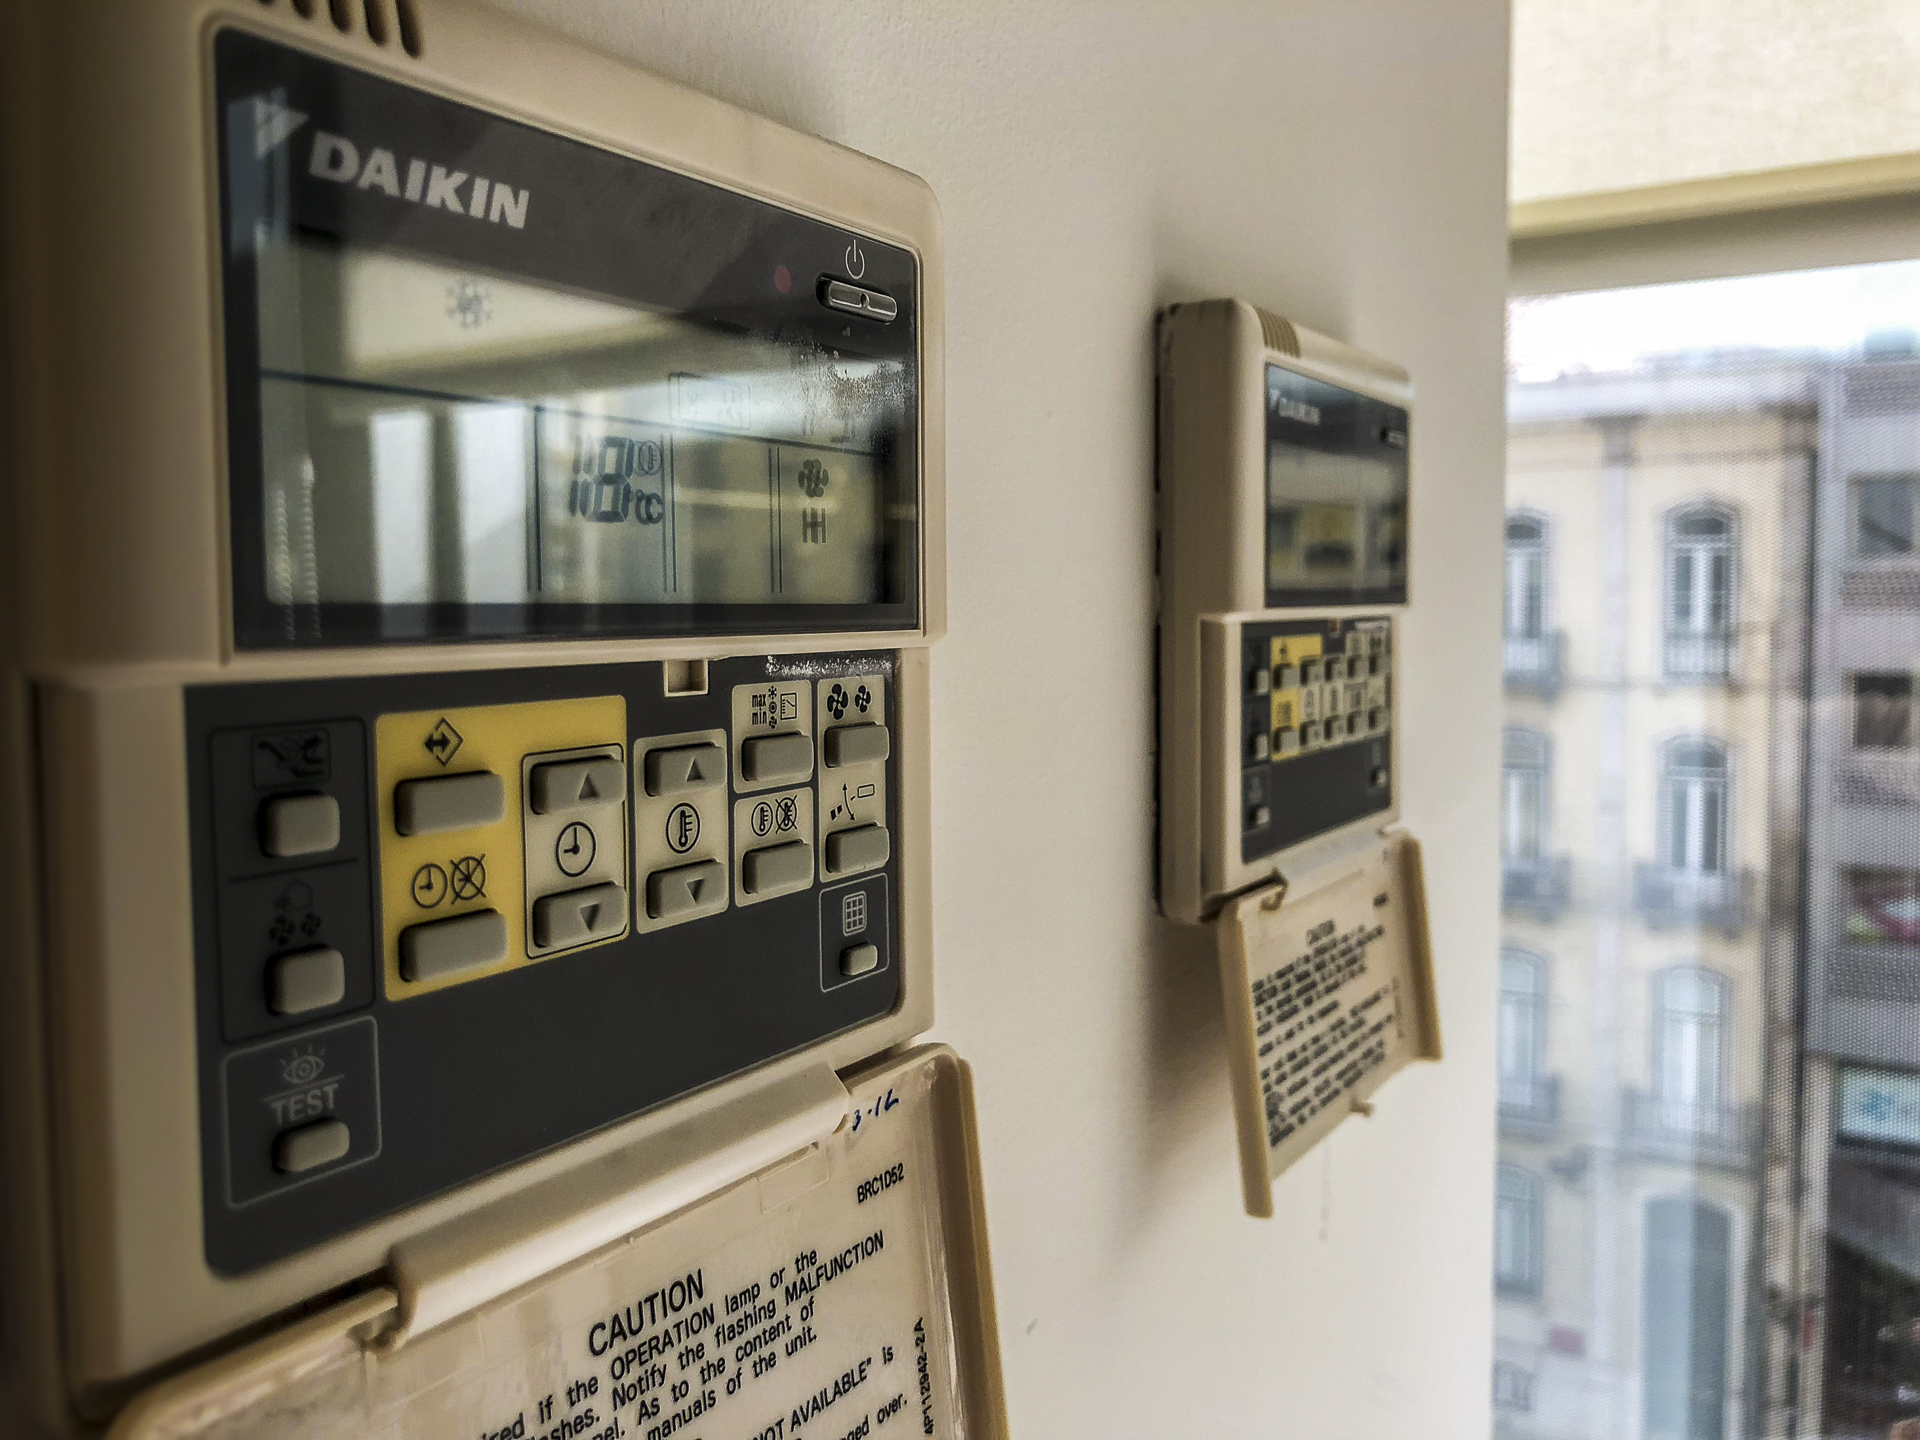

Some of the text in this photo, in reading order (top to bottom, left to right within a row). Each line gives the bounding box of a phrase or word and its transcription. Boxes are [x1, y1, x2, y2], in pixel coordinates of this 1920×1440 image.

[309, 131, 530, 229] DAIKIN
[752, 693, 767, 708] max
[752, 708, 767, 725] min
[270, 1083, 339, 1126] TEST
[857, 1162, 904, 1203] BRC1D52
[538, 1394, 553, 1425] if
[567, 1376, 599, 1407] the
[611, 1303, 715, 1380] OPERATION
[725, 1282, 761, 1315] lamp
[770, 1267, 785, 1289] or
[795, 1250, 817, 1274] the
[588, 1267, 704, 1356] CAUTION
[612, 1364, 667, 1411] Notify
[678, 1343, 705, 1370] the
[715, 1299, 776, 1348] flashing
[784, 1229, 884, 1306] MALFUNCTION
[638, 1397, 660, 1425] As
[671, 1380, 689, 1403] to
[700, 1357, 726, 1385] the
[735, 1314, 792, 1362] content
[800, 1296, 814, 1321] of
[648, 1327, 817, 1440] manuals of the unit.
[882, 1346, 894, 1364] is
[877, 1393, 907, 1423] over.
